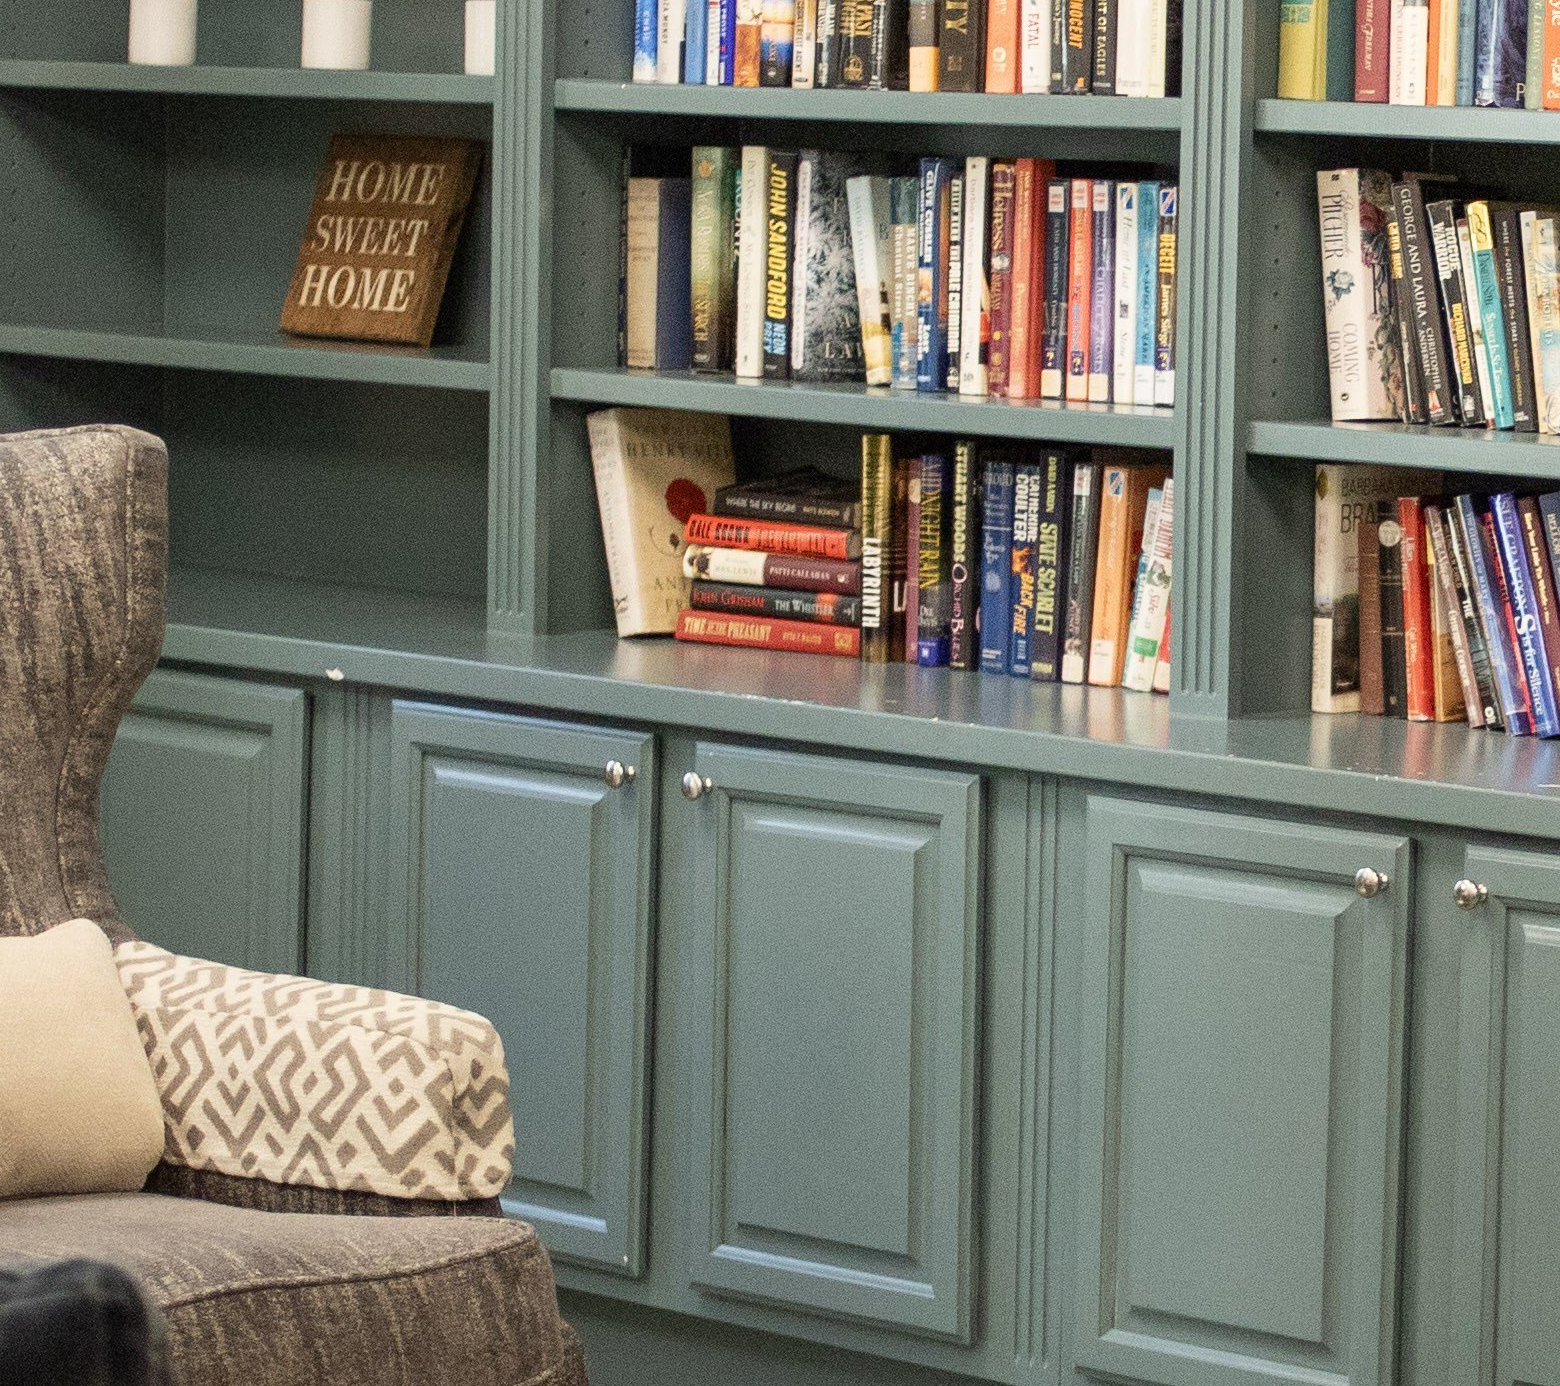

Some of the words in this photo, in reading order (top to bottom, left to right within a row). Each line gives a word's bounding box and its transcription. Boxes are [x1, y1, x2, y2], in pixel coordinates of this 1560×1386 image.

[1026, 12, 1041, 50] FATAL
[1096, 16, 1109, 32] OF
[1095, 35, 1108, 76] EAGLES
[325, 159, 446, 206] HOME
[769, 163, 787, 216] JOHN
[311, 214, 429, 257] SWEET
[1320, 194, 1347, 260] PILCHER
[1400, 188, 1419, 242] GEORGE
[766, 219, 787, 320] SANDFORD
[905, 227, 916, 269] MAEVE
[1158, 232, 1176, 274] DECEIT
[1405, 244, 1421, 275] AND
[298, 264, 415, 313] HOME
[904, 273, 915, 318] BINCHY
[1409, 276, 1428, 319] LAURA
[772, 323, 787, 356] NEON
[1328, 331, 1344, 374] HOME
[1343, 322, 1361, 383] COMING
[1038, 522, 1059, 565] STATE
[861, 536, 881, 628] LABYRINTH
[1033, 566, 1057, 636] SCARLET
